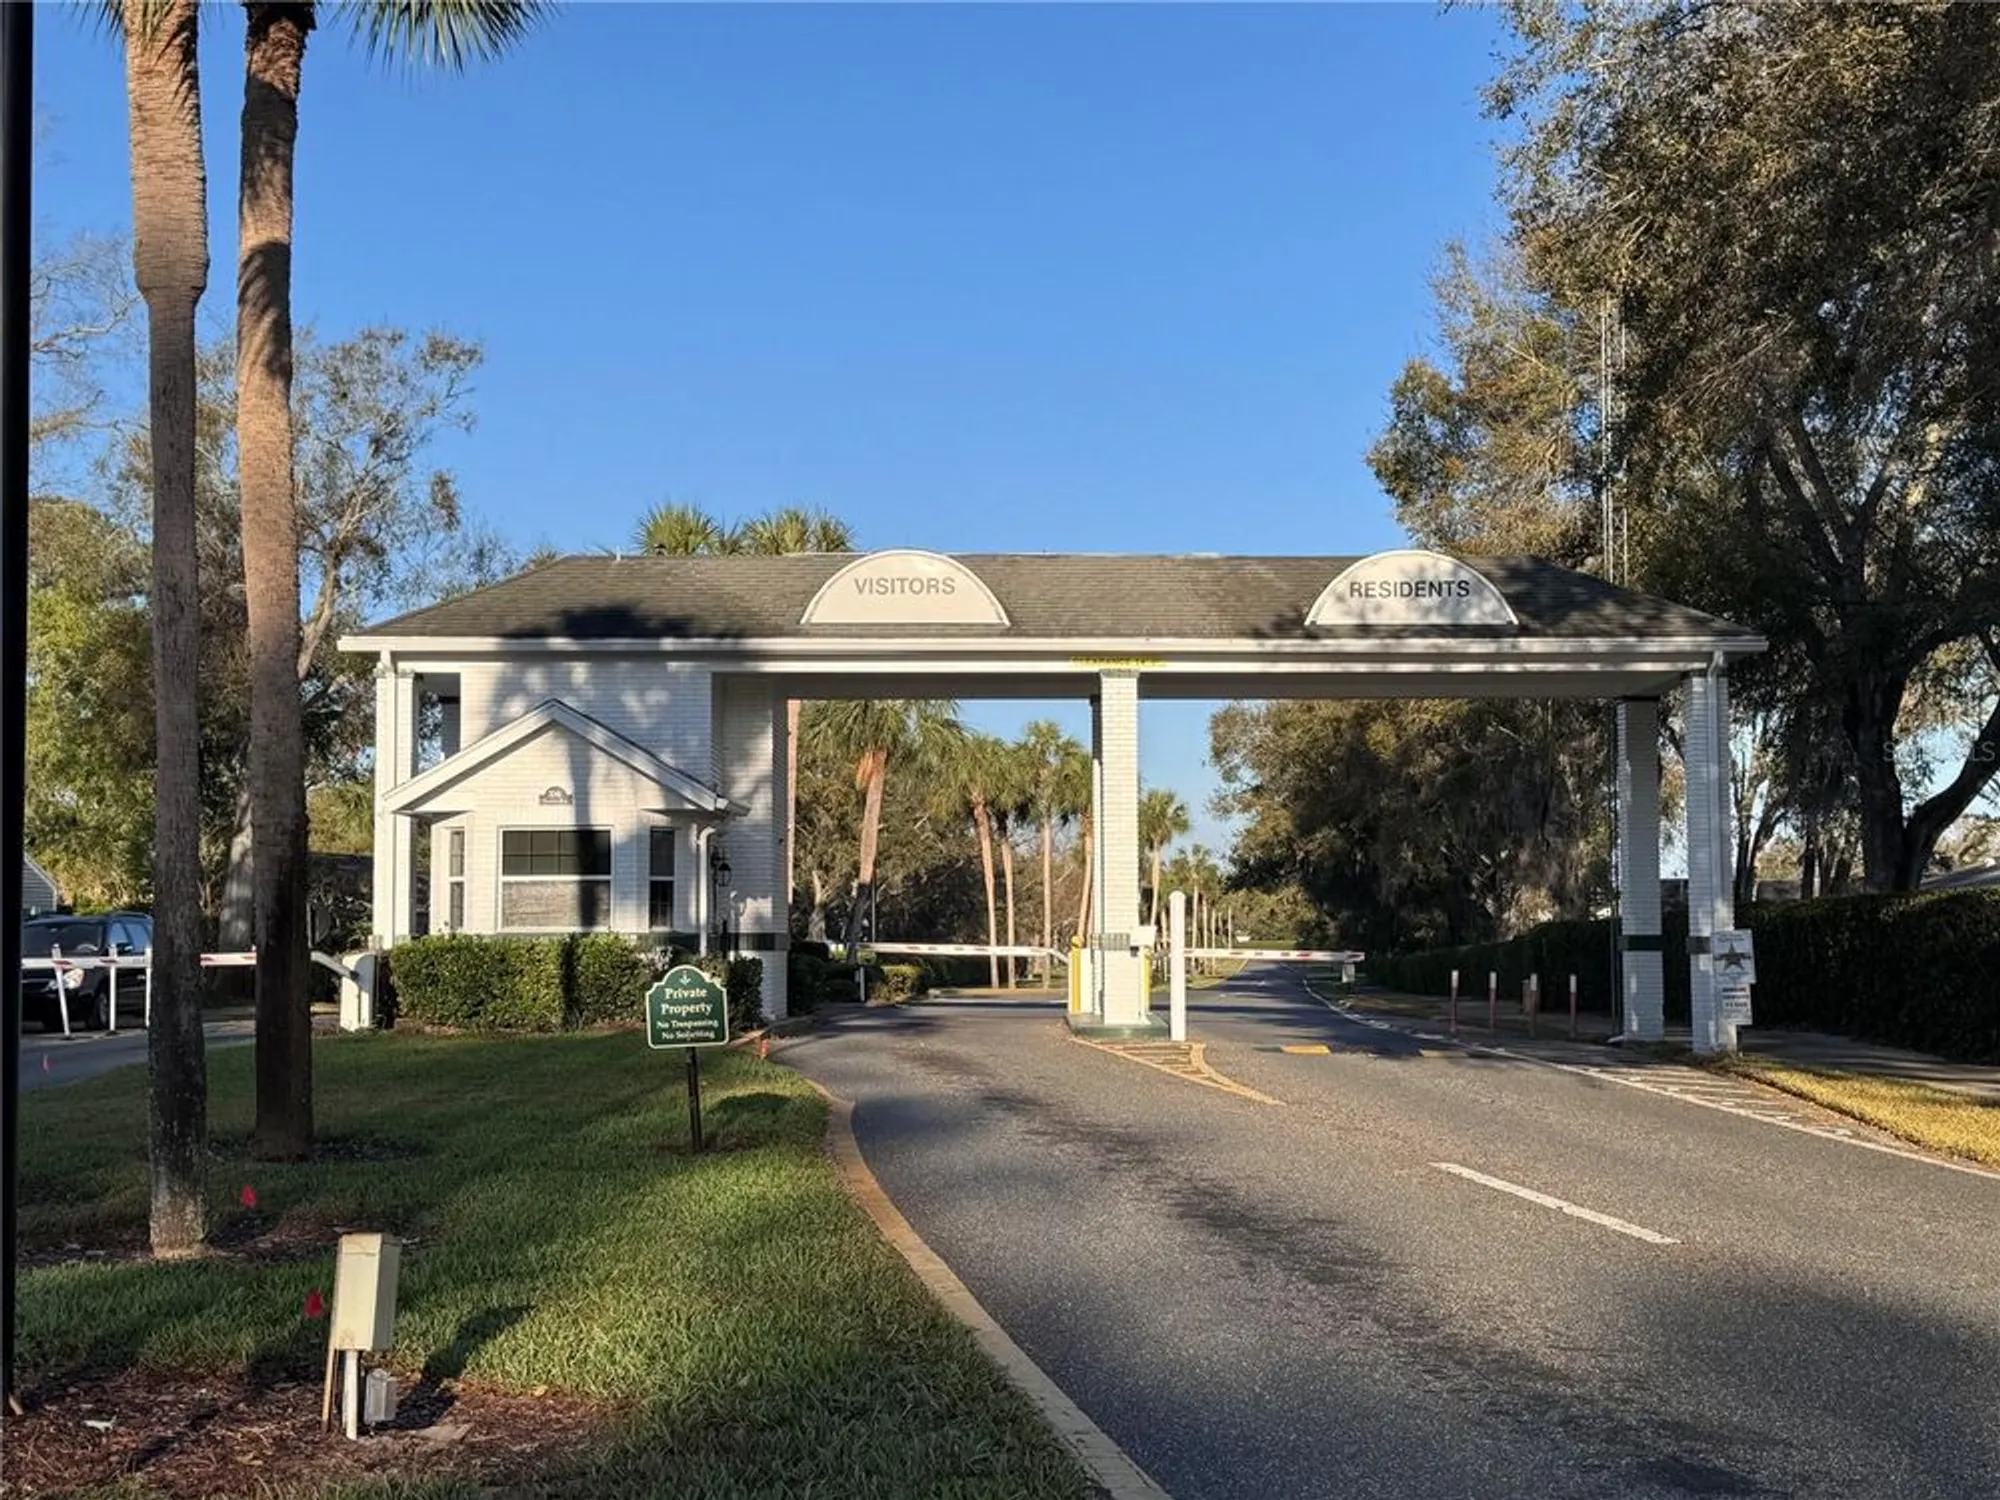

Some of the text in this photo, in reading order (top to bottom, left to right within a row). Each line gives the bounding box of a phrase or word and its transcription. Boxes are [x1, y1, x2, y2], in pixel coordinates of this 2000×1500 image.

[854, 577, 955, 595] VISITORS
[1349, 580, 1470, 598] RESIDENTS
[664, 987, 708, 999] Private
[660, 1002, 713, 1016] Property
[656, 1020, 669, 1029] No
[661, 1032, 675, 1040] No
